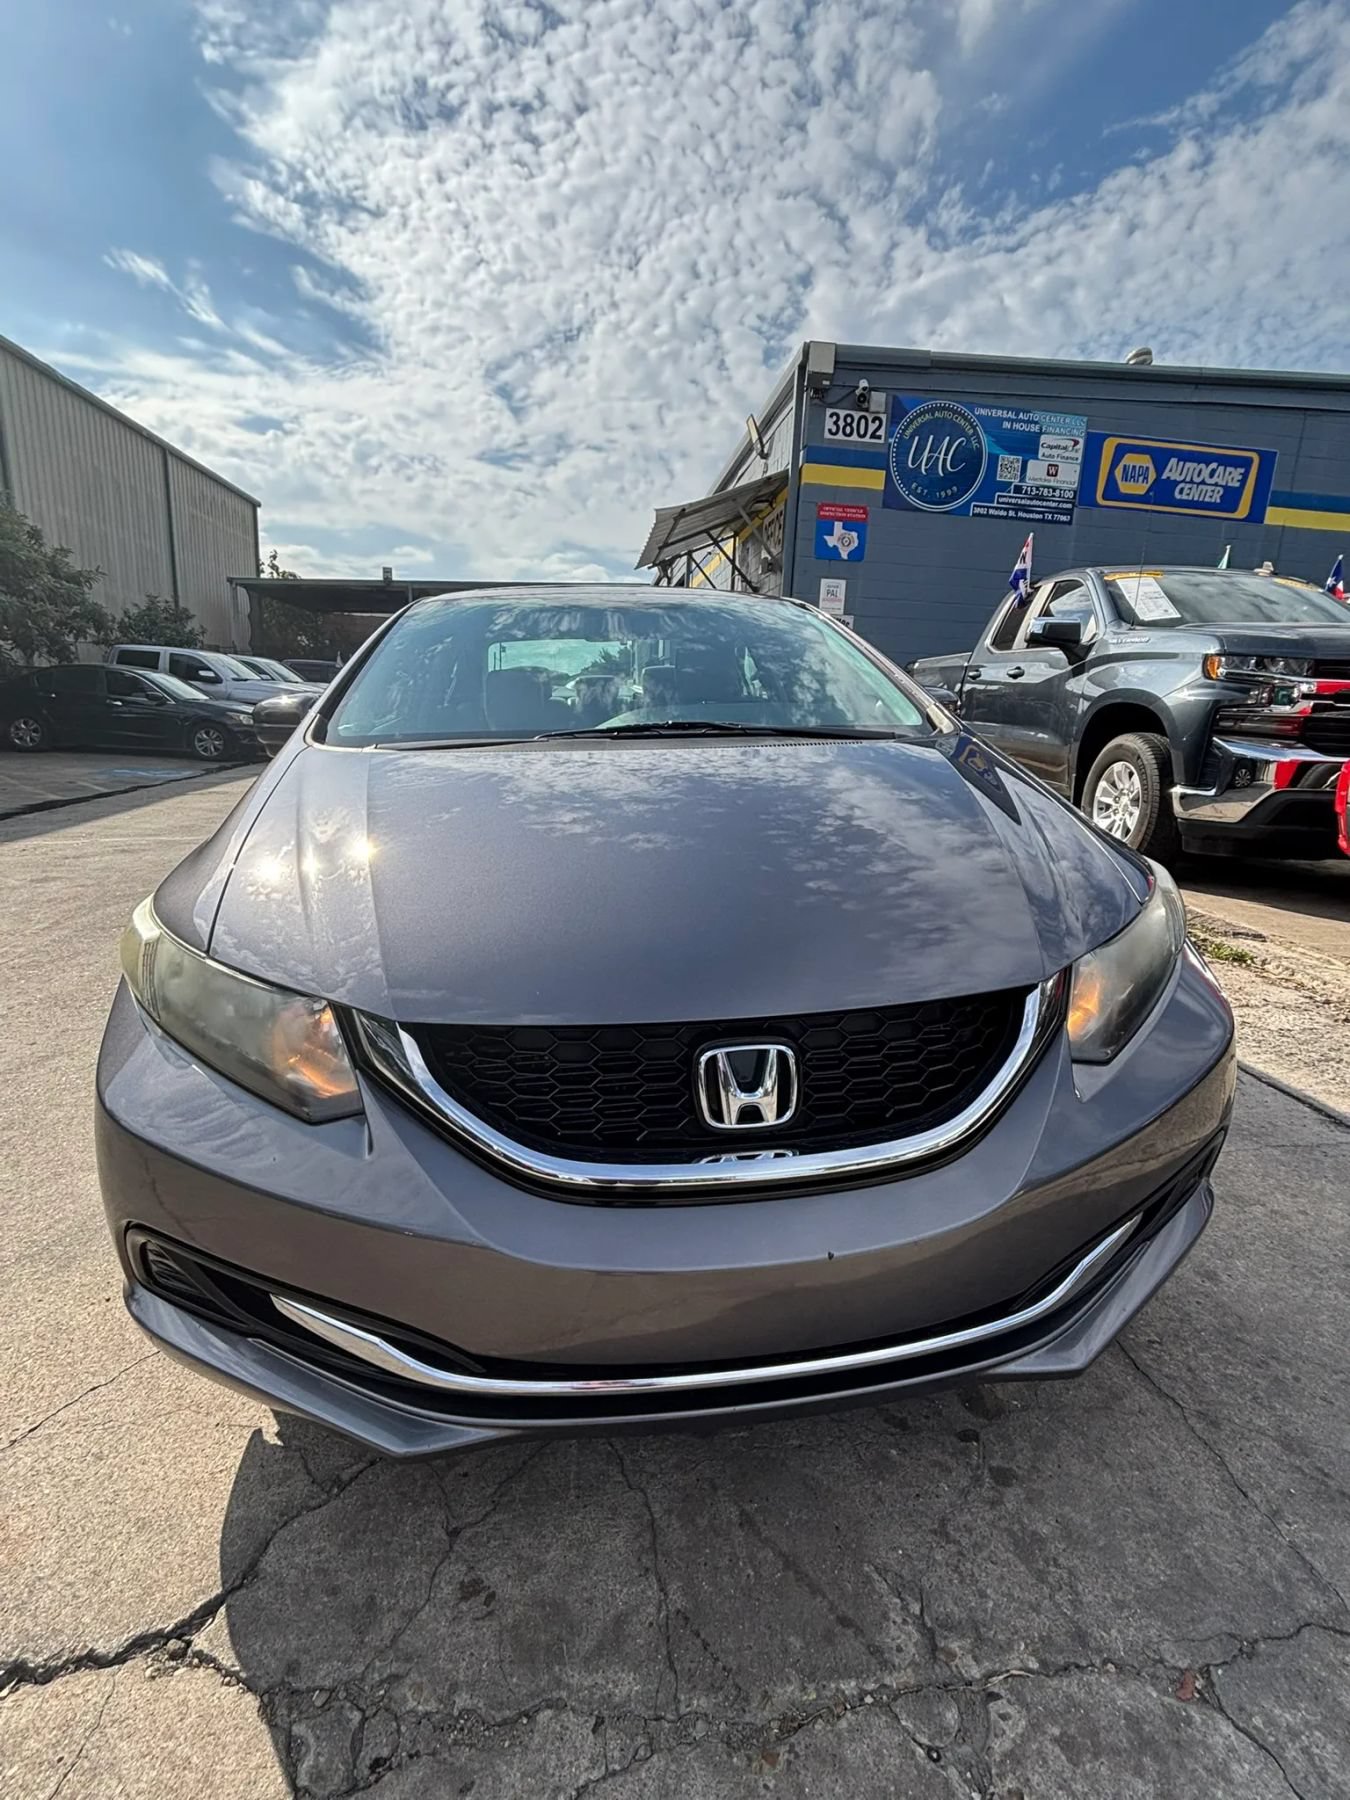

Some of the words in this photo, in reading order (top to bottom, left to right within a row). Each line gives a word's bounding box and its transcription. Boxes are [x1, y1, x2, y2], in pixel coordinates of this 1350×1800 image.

[974, 407, 1017, 419] UNIVERSAL
[1018, 412, 1040, 421] AUTO
[1041, 414, 1071, 425] CENTER
[828, 411, 883, 440] 3802
[903, 411, 934, 440] UNIVERSAL
[934, 410, 953, 419] AUTO
[953, 412, 974, 436] CENTER
[970, 434, 980, 450] LLC
[1002, 420, 1011, 429] IN
[1012, 422, 1040, 432] HOUSE
[1041, 425, 1085, 437] FINANCING
[1041, 442, 1067, 450] Capital
[908, 435, 966, 477] UAC
[1056, 453, 1079, 461] Finance
[1122, 463, 1150, 485] NAPA
[1022, 486, 1074, 498] 713-783-8100
[1174, 482, 1224, 503] CENTER
[998, 497, 1073, 509] universalautocenter.com
[1017, 511, 1043, 519] Houston
